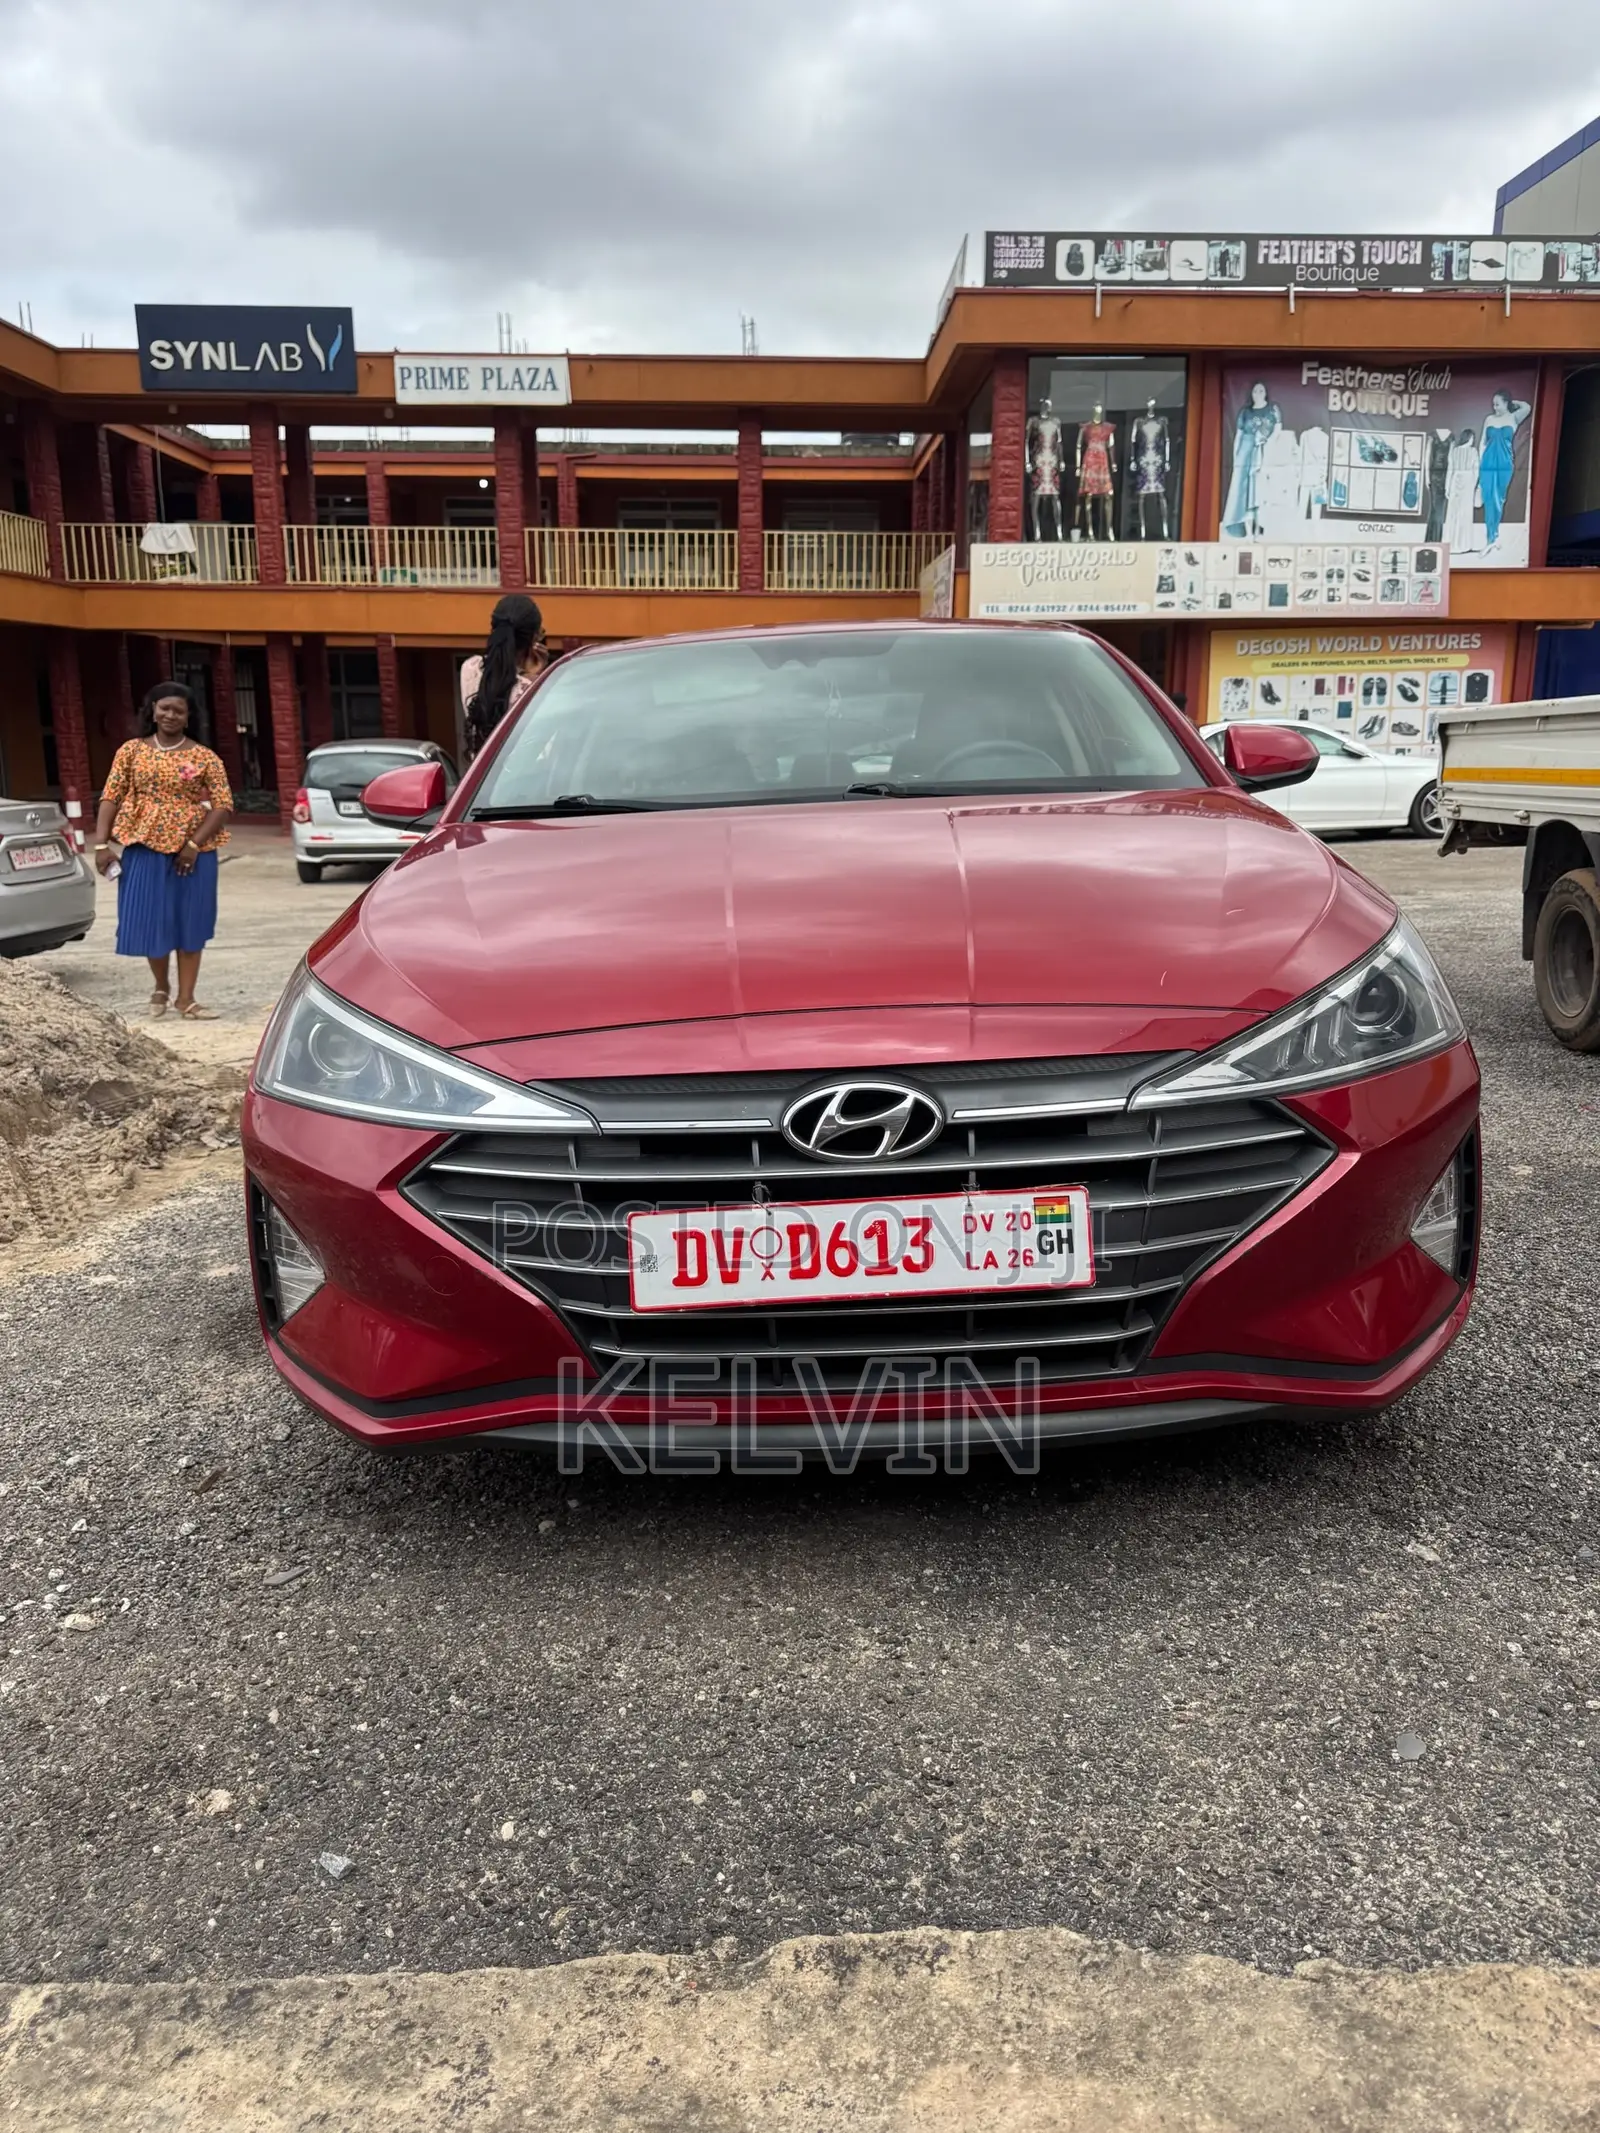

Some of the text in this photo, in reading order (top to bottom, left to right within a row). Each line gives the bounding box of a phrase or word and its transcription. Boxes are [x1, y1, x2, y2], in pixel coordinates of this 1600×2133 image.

[1257, 239, 1423, 265] FEATHER'S TOUCH
[1295, 264, 1380, 283] Boutique
[149, 339, 304, 373] SYNLAB
[399, 366, 559, 392] PRIME PLAZA
[1328, 389, 1430, 419] BOUTIQUE
[983, 548, 1138, 569] DEGOSH WORLD
[1021, 562, 1101, 588] Ventures
[1236, 633, 1482, 656] DEGOSH WORLD VENTURES
[963, 1211, 1033, 1234] DV 20
[1036, 1228, 1074, 1256] GH
[672, 1226, 745, 1287] DV
[965, 1248, 1034, 1271] LA 26
